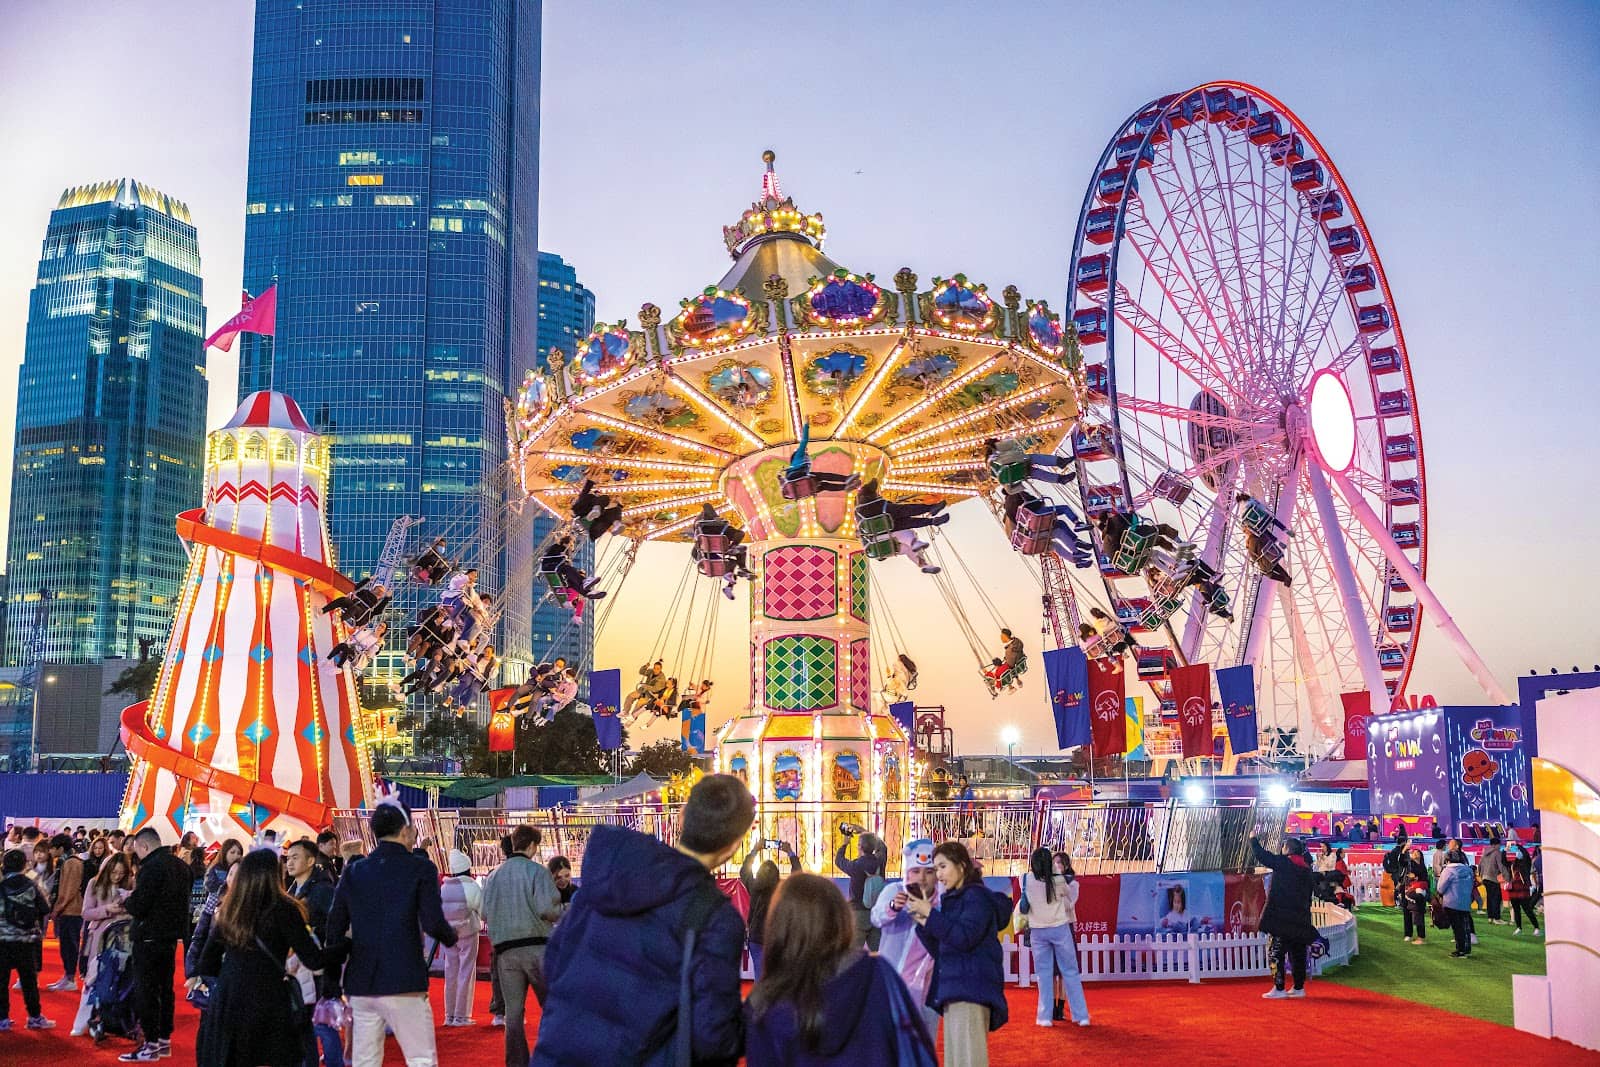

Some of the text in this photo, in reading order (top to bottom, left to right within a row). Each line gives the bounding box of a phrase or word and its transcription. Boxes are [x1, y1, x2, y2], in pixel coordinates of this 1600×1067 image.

[1389, 695, 1437, 714] AIA
[1098, 709, 1119, 722] AIA
[1187, 714, 1205, 727] AIA
